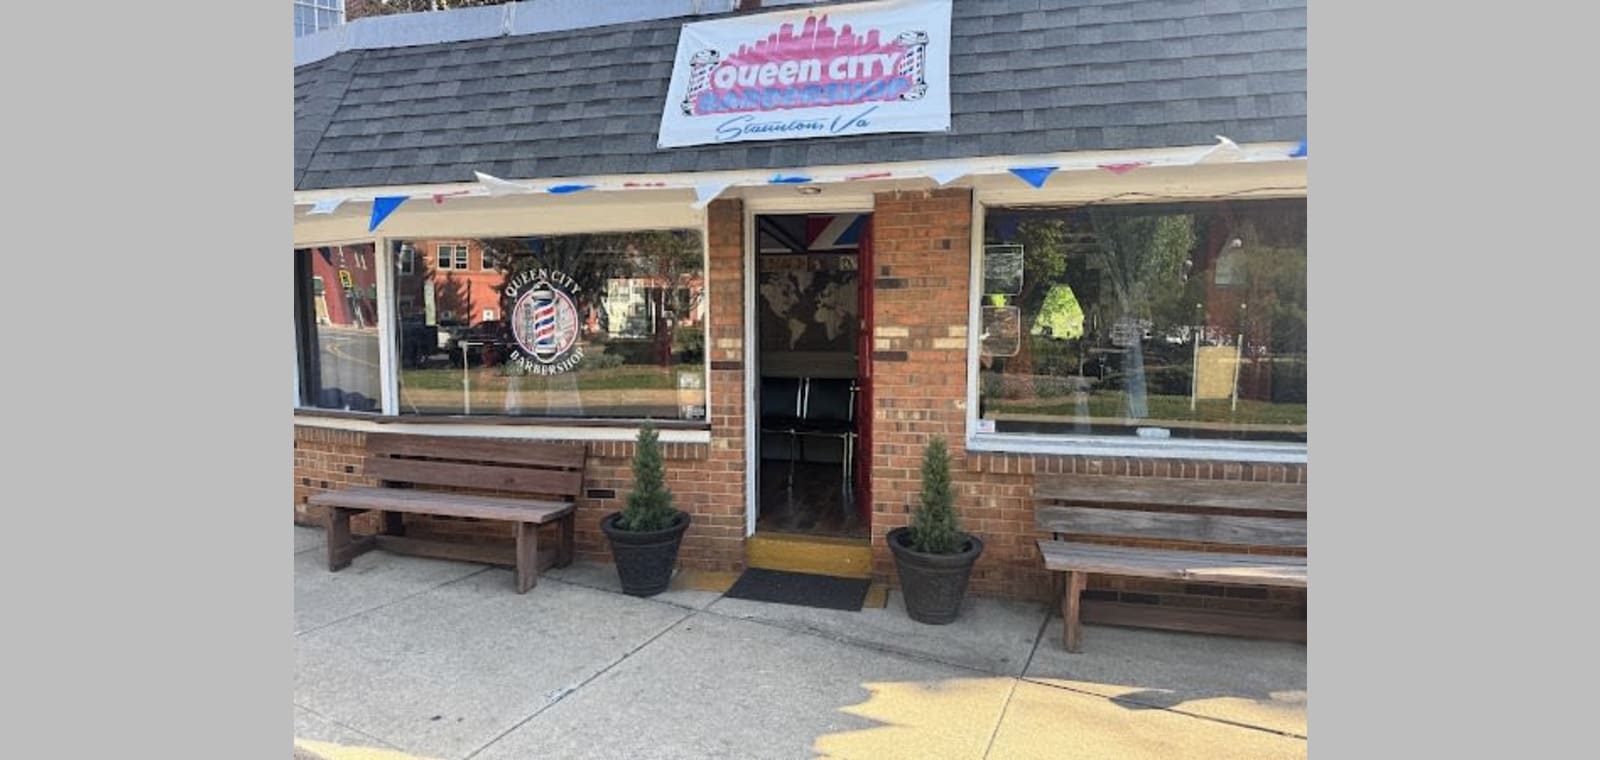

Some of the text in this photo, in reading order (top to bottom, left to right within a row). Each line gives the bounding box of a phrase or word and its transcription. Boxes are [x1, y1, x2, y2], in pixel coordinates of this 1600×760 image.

[829, 52, 901, 80] CITY
[830, 105, 879, 134] Va
[505, 268, 581, 297] QUEEN CITY
[509, 347, 585, 376] BARBERSHOP
